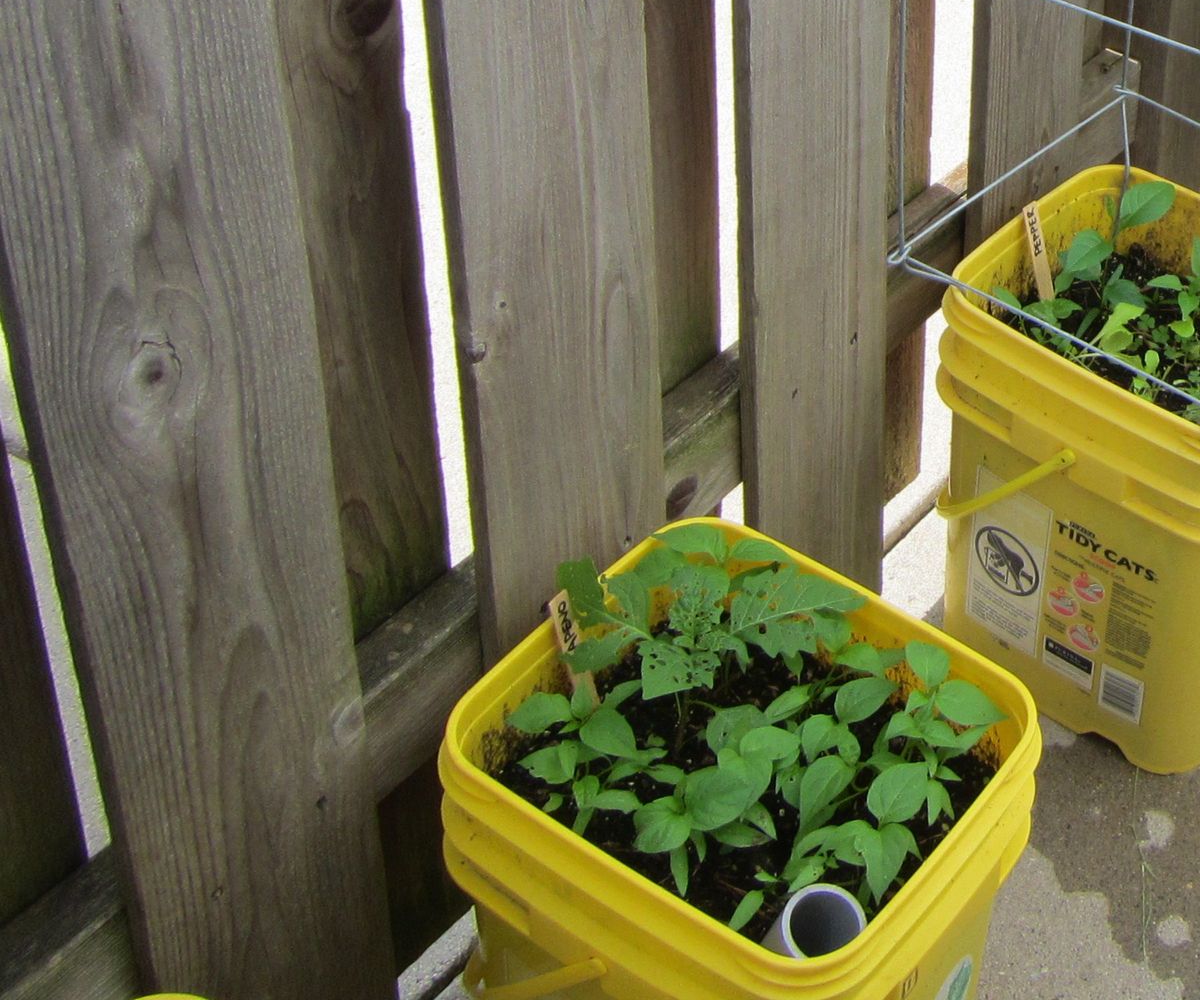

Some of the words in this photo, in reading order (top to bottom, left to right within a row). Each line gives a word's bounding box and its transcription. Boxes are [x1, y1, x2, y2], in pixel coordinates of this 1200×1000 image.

[1027, 207, 1042, 257] PEPPER
[1055, 520, 1102, 553] TIDY
[1104, 549, 1156, 582] CATS
